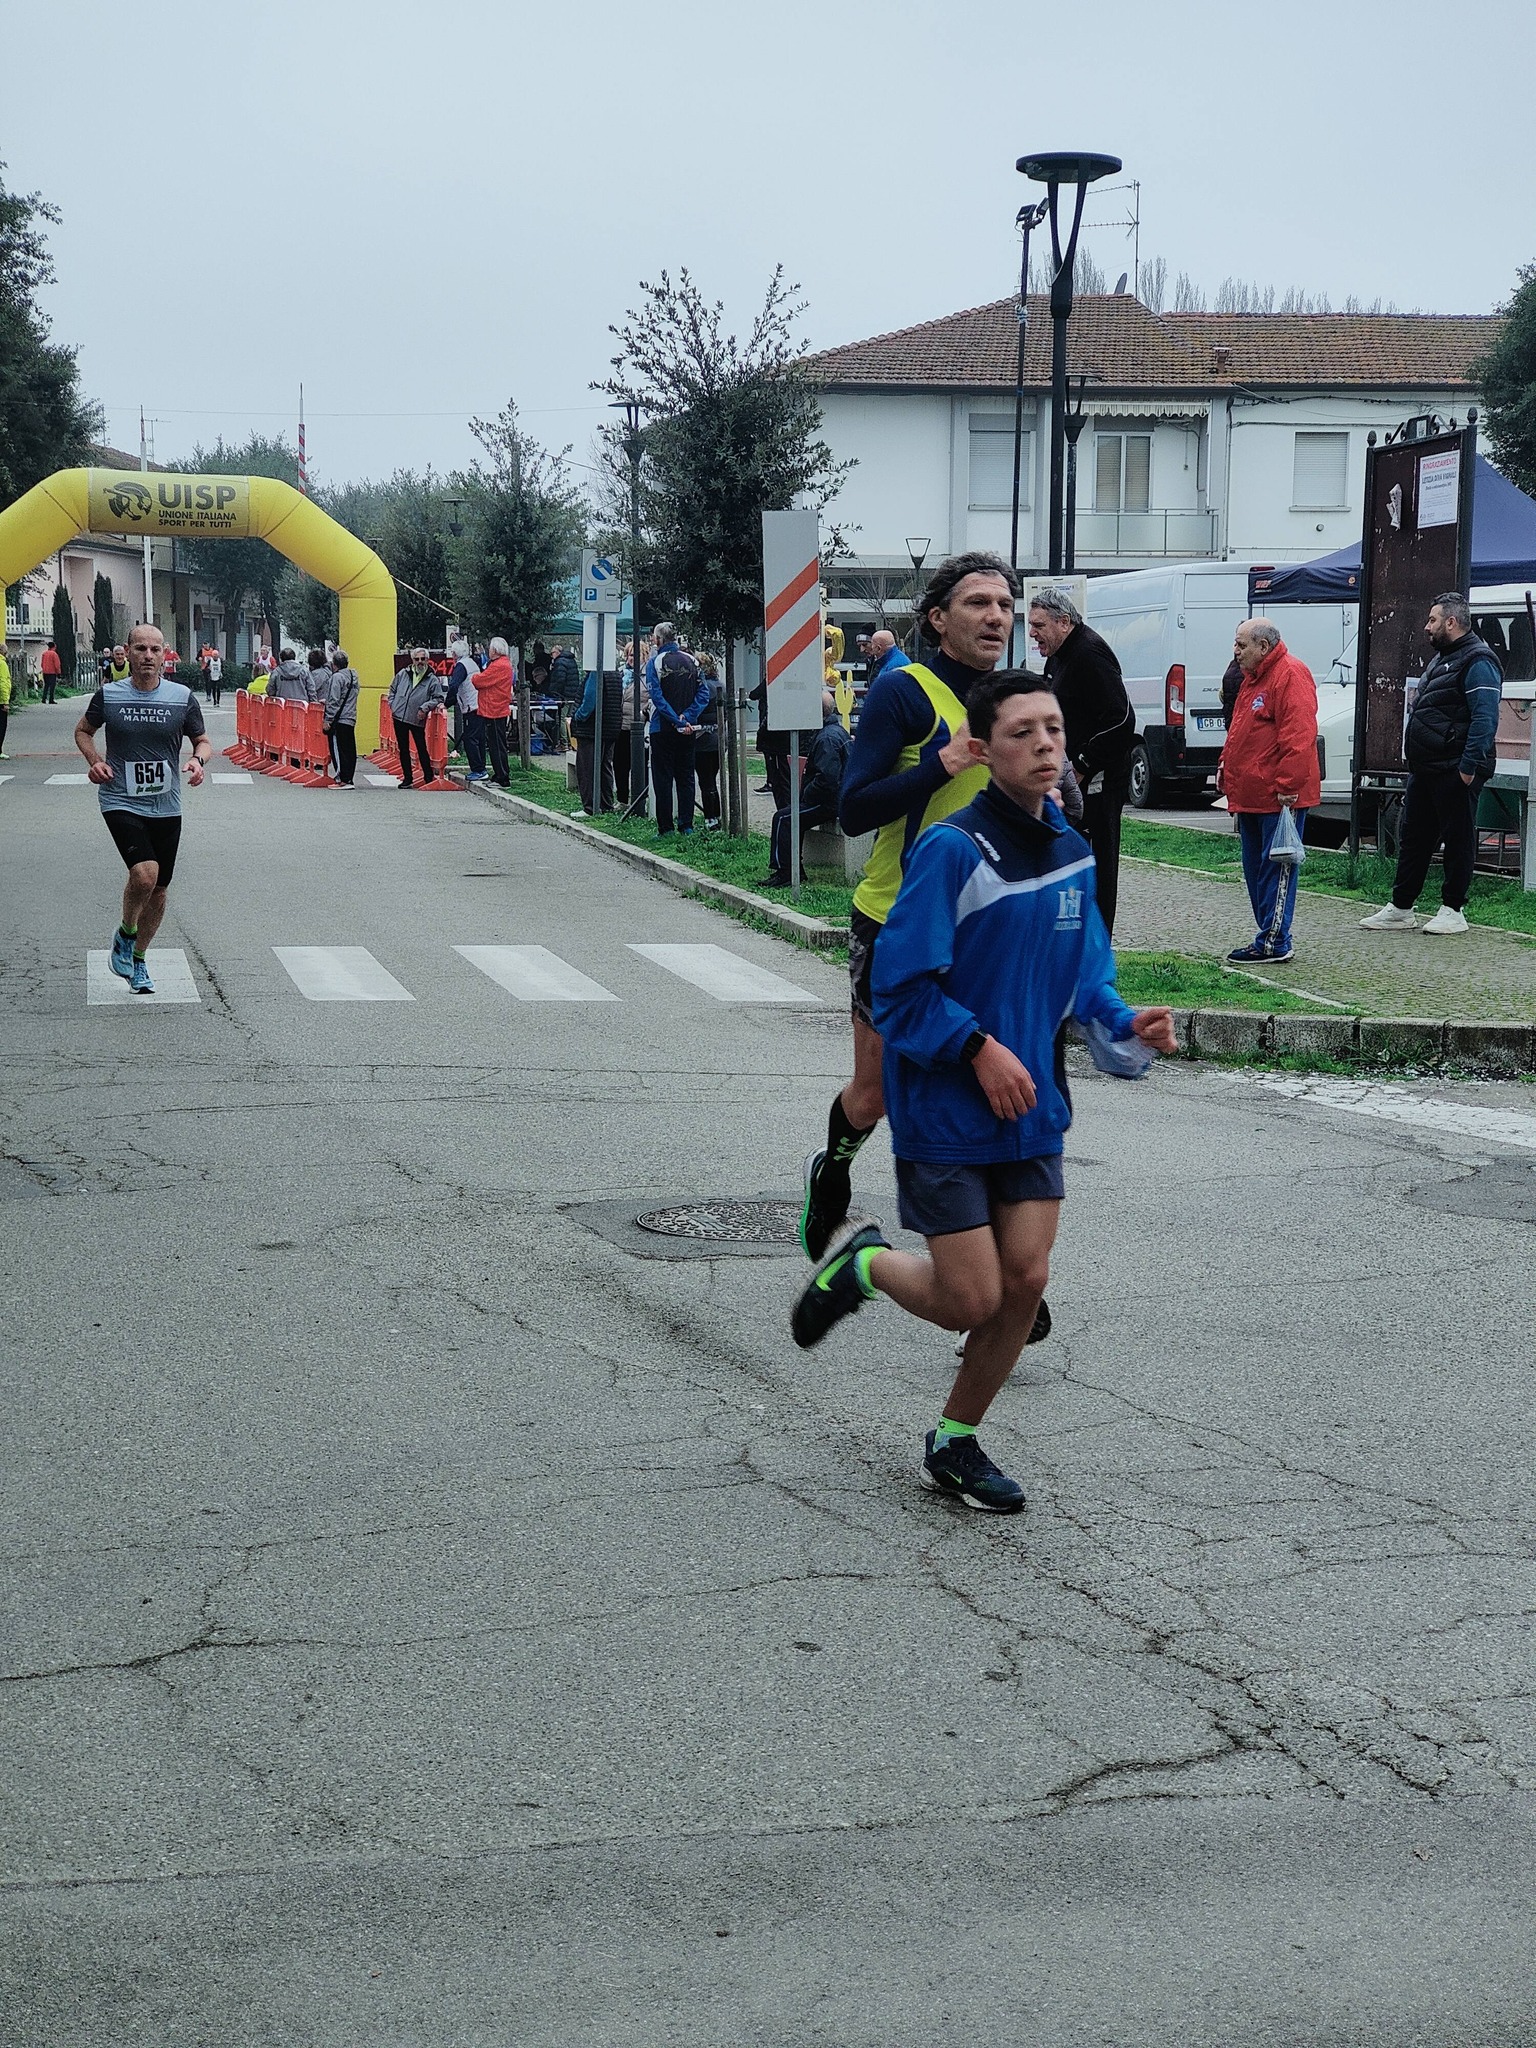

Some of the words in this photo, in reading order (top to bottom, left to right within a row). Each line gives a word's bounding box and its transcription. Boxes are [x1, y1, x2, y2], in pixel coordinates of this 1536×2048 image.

[158, 483, 236, 510] UISP
[158, 510, 194, 519] UNIONE
[197, 511, 237, 521] ITALIANA
[158, 518, 186, 527] SPORT
[190, 520, 205, 528] PER
[209, 520, 232, 528] TUTTI
[586, 589, 595, 600] P
[119, 707, 172, 716] ATLETICA
[123, 715, 167, 723] MAMELI
[134, 762, 165, 784] 654
